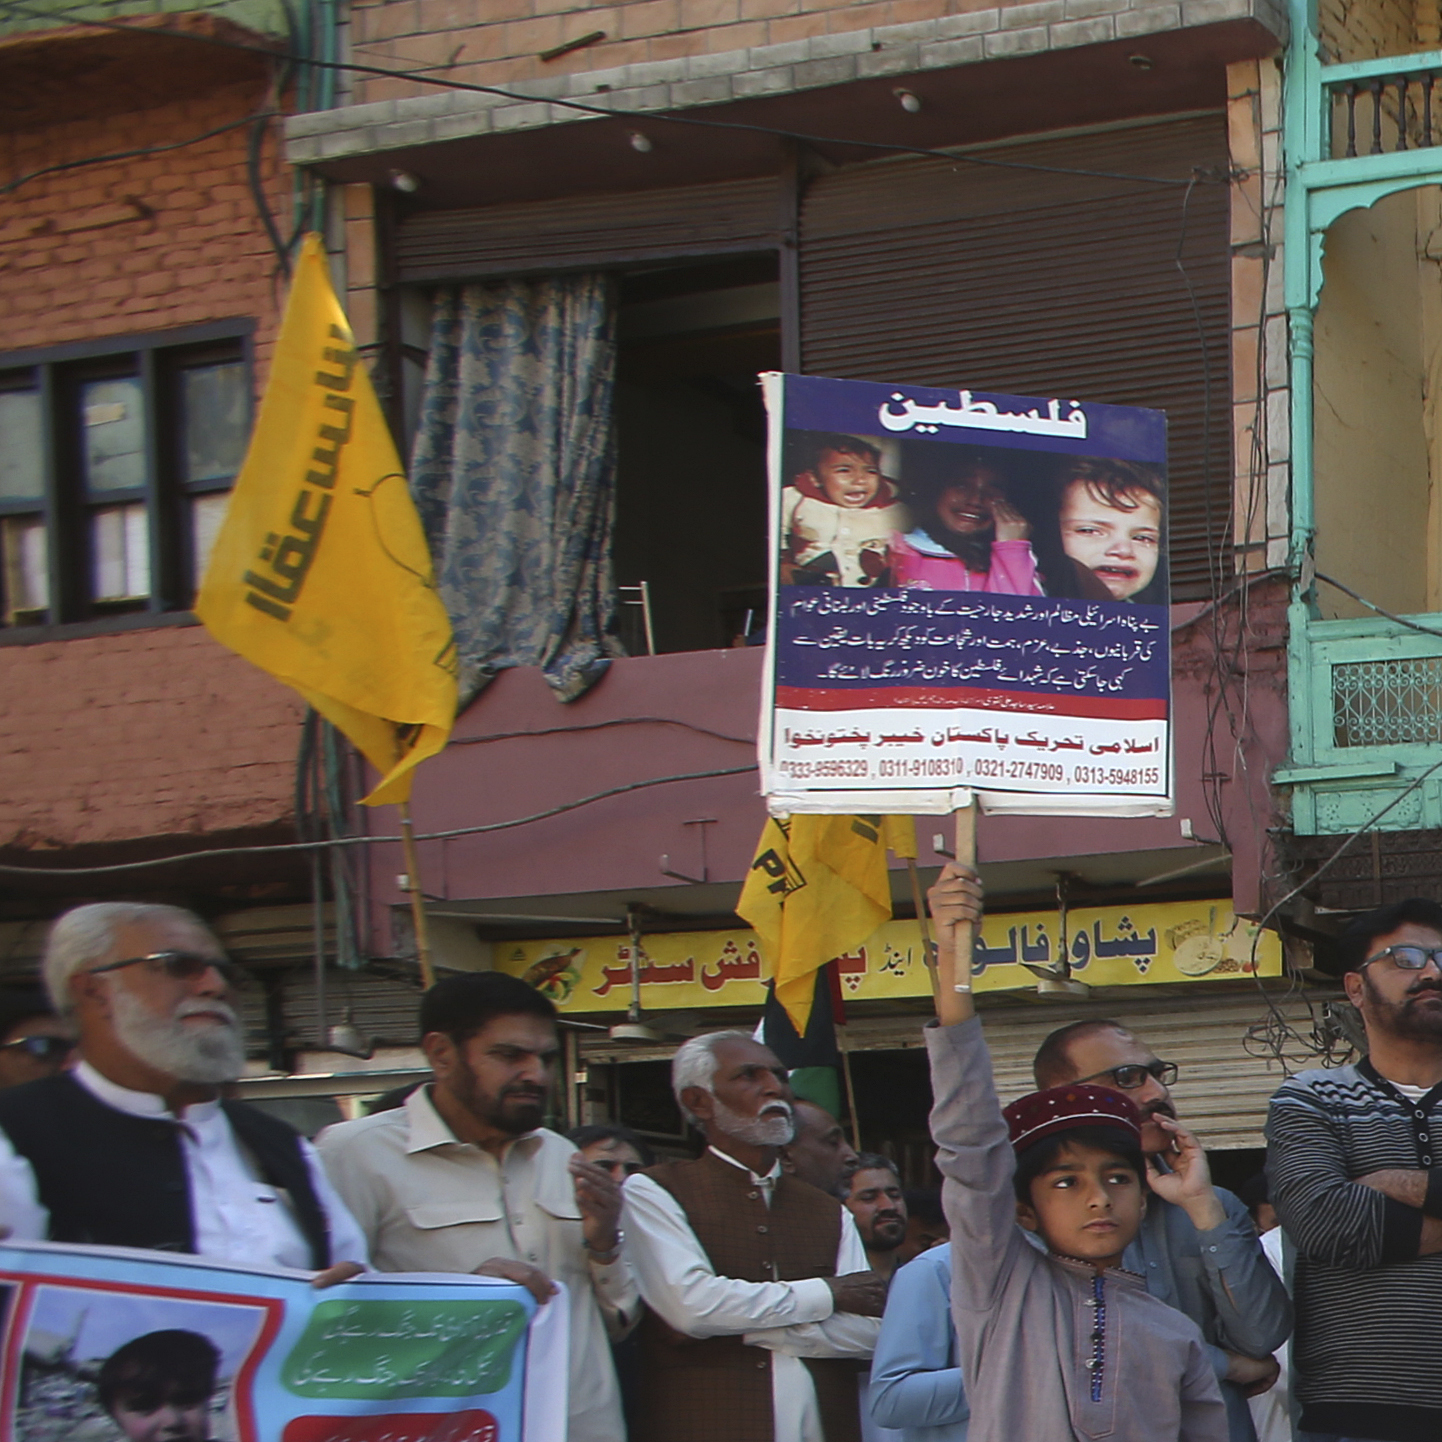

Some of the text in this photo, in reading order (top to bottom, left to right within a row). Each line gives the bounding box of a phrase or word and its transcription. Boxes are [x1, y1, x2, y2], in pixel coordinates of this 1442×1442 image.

[879, 389, 1087, 439] فلسطین
[790, 597, 818, 618] عوام
[934, 598, 955, 615] کے
[1002, 604, 1034, 621] شدید
[1032, 610, 1048, 621] اور
[1049, 603, 1079, 627] مظالم
[1139, 619, 1159, 633] بے
[986, 639, 1017, 649] ہمت
[1139, 641, 1157, 661] کی
[1051, 675, 1073, 691] ہے
[784, 726, 1159, 755] اسلامی تحریک پاکستان خیبر پختونخوا
[879, 757, 963, 777] 0311-9108310
[975, 758, 1063, 782] 0321-2747909
[1074, 765, 1159, 784] 0313-5948155
[701, 941, 760, 990] فش
